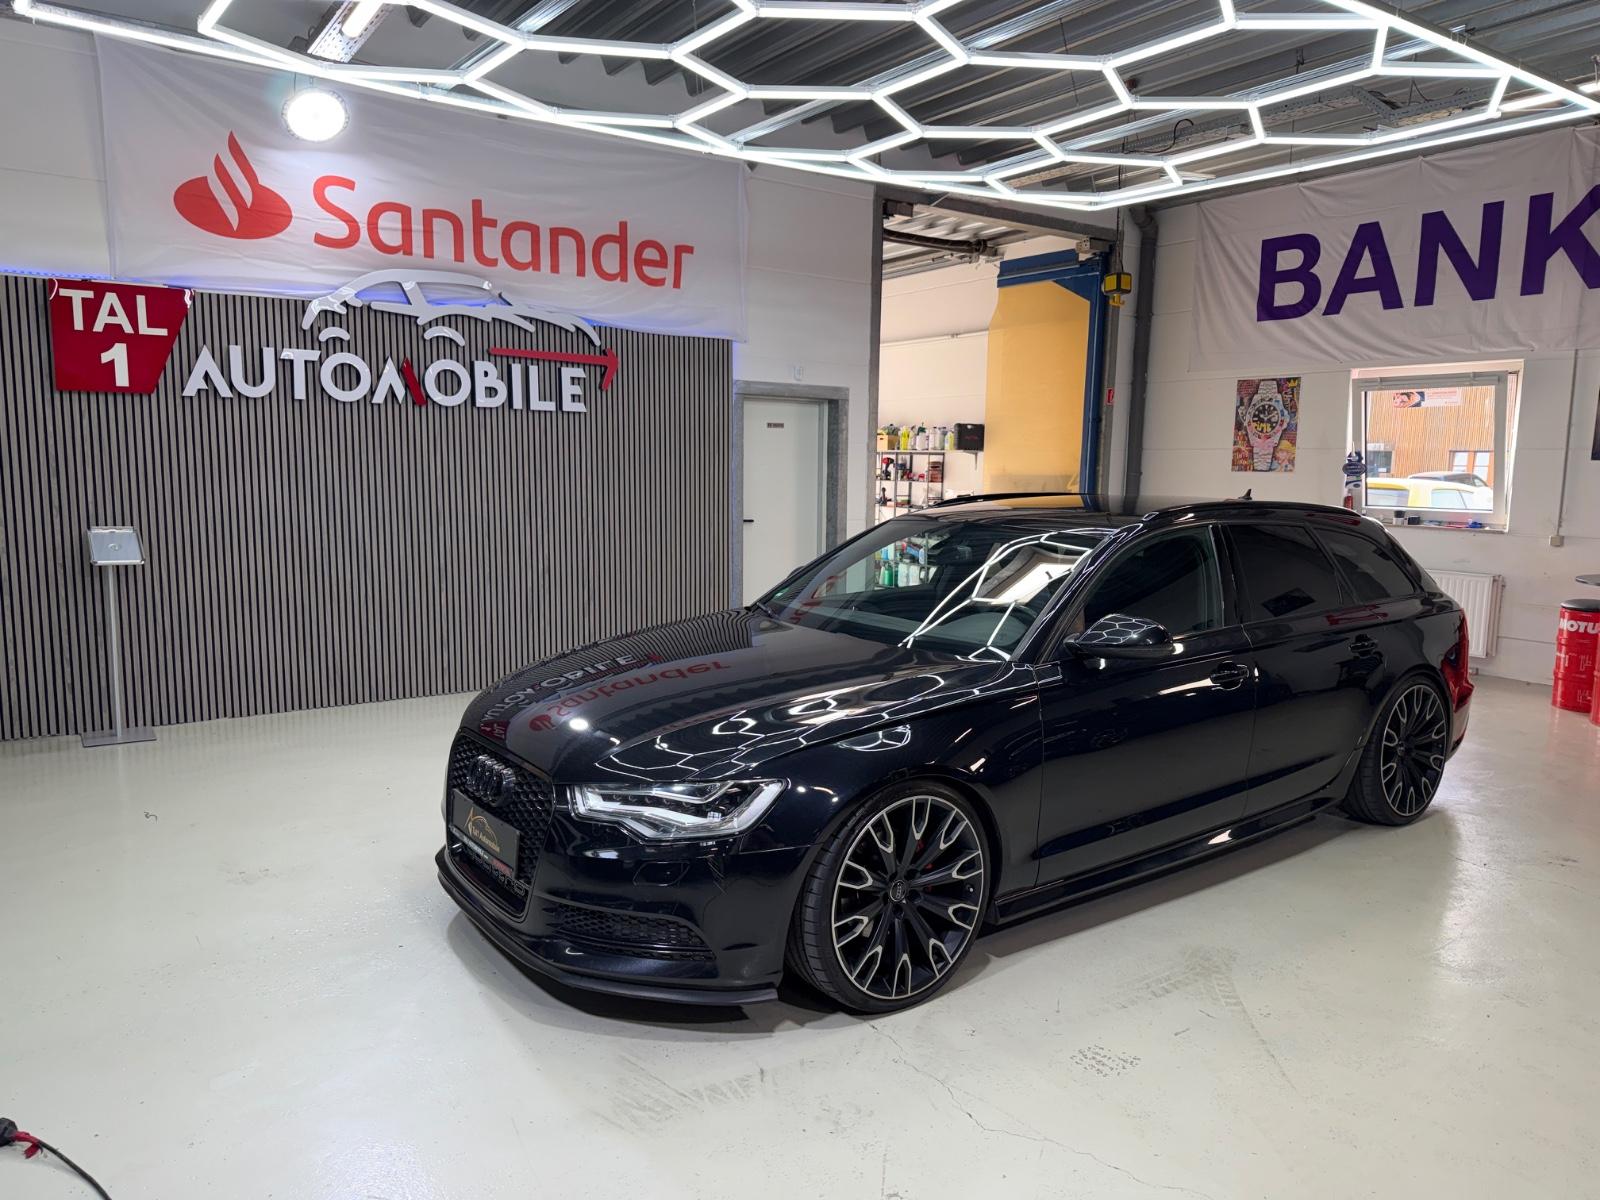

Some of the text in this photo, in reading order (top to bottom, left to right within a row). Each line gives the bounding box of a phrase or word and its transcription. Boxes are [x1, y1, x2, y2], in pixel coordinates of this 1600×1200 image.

[313, 174, 694, 289] Santander
[1257, 183, 1600, 322] BANK
[59, 288, 168, 336] TAL
[100, 342, 130, 387] 1
[182, 345, 588, 412] AUTOMOBILE
